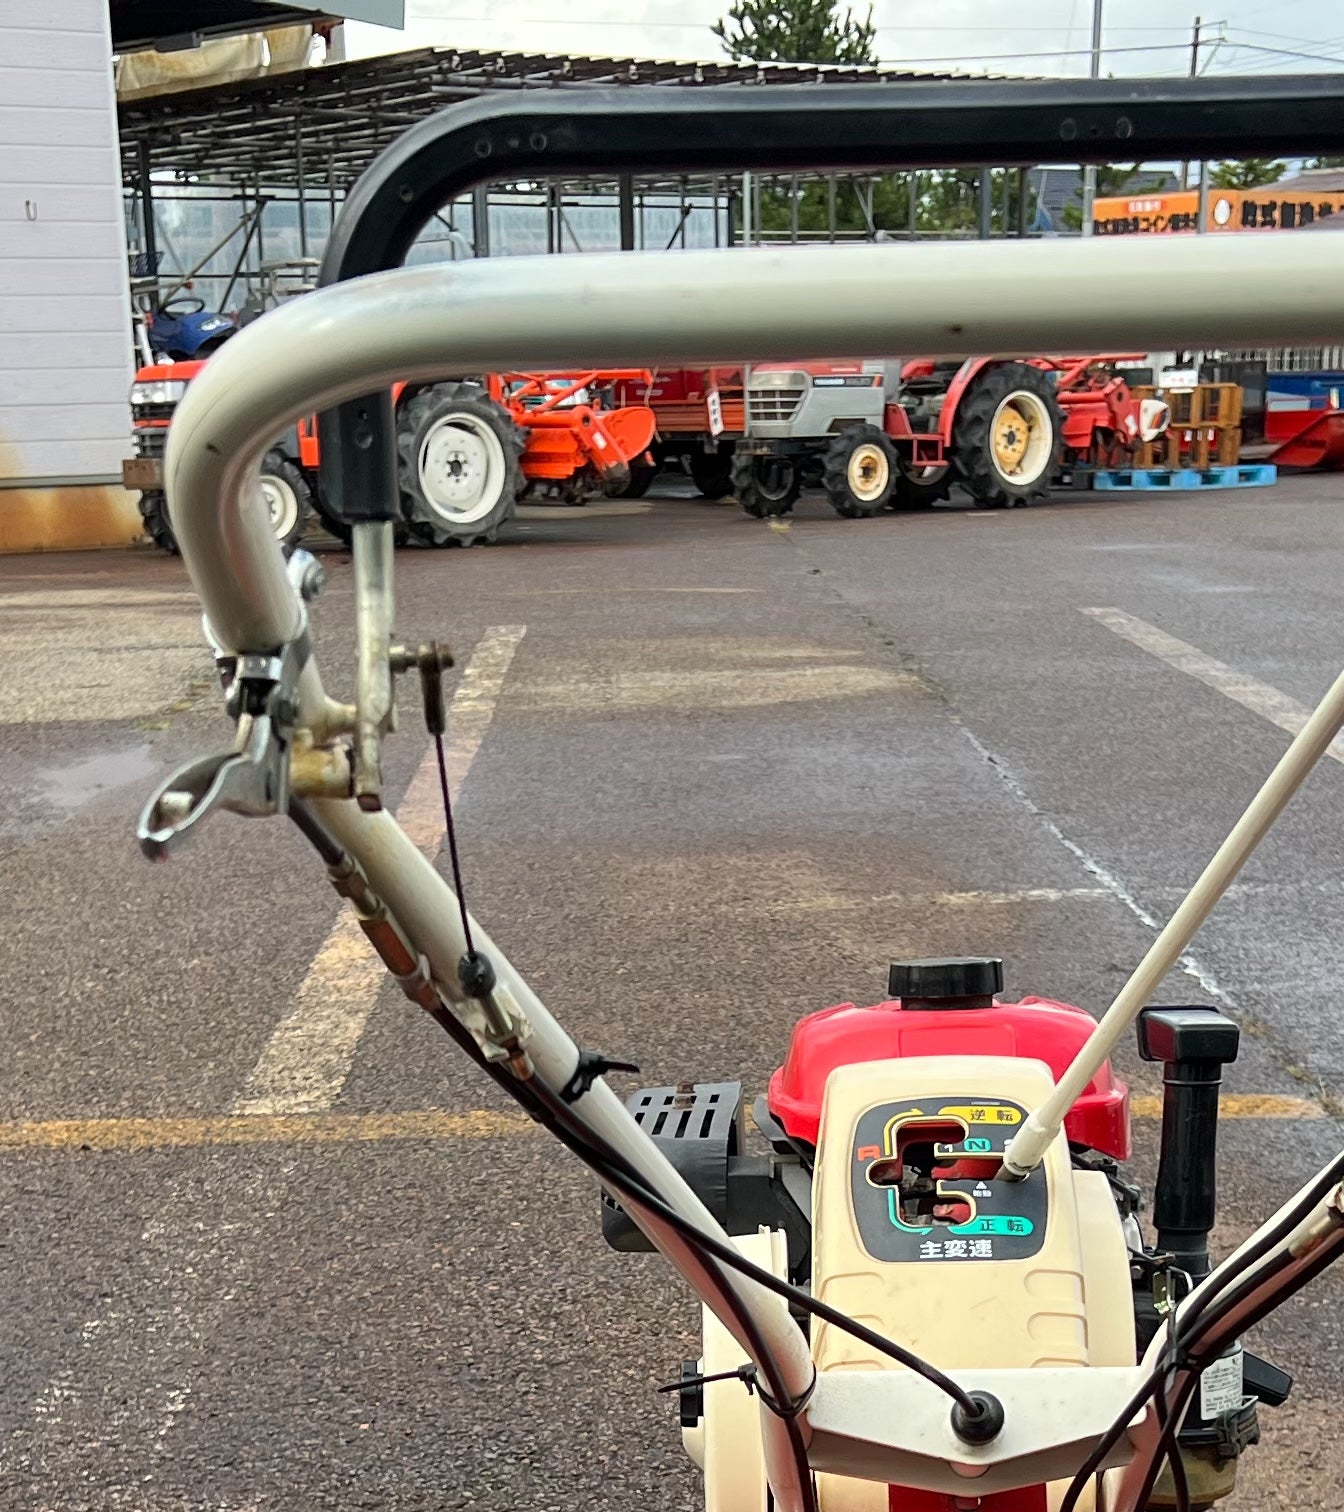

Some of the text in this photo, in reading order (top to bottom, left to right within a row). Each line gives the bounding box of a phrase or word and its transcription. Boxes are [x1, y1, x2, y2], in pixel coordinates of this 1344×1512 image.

[970, 1109, 1013, 1121] 逆転
[968, 1140, 987, 1150] N
[857, 1145, 881, 1162] R
[979, 1219, 1025, 1233] 正転
[919, 1239, 993, 1259] 主変速
